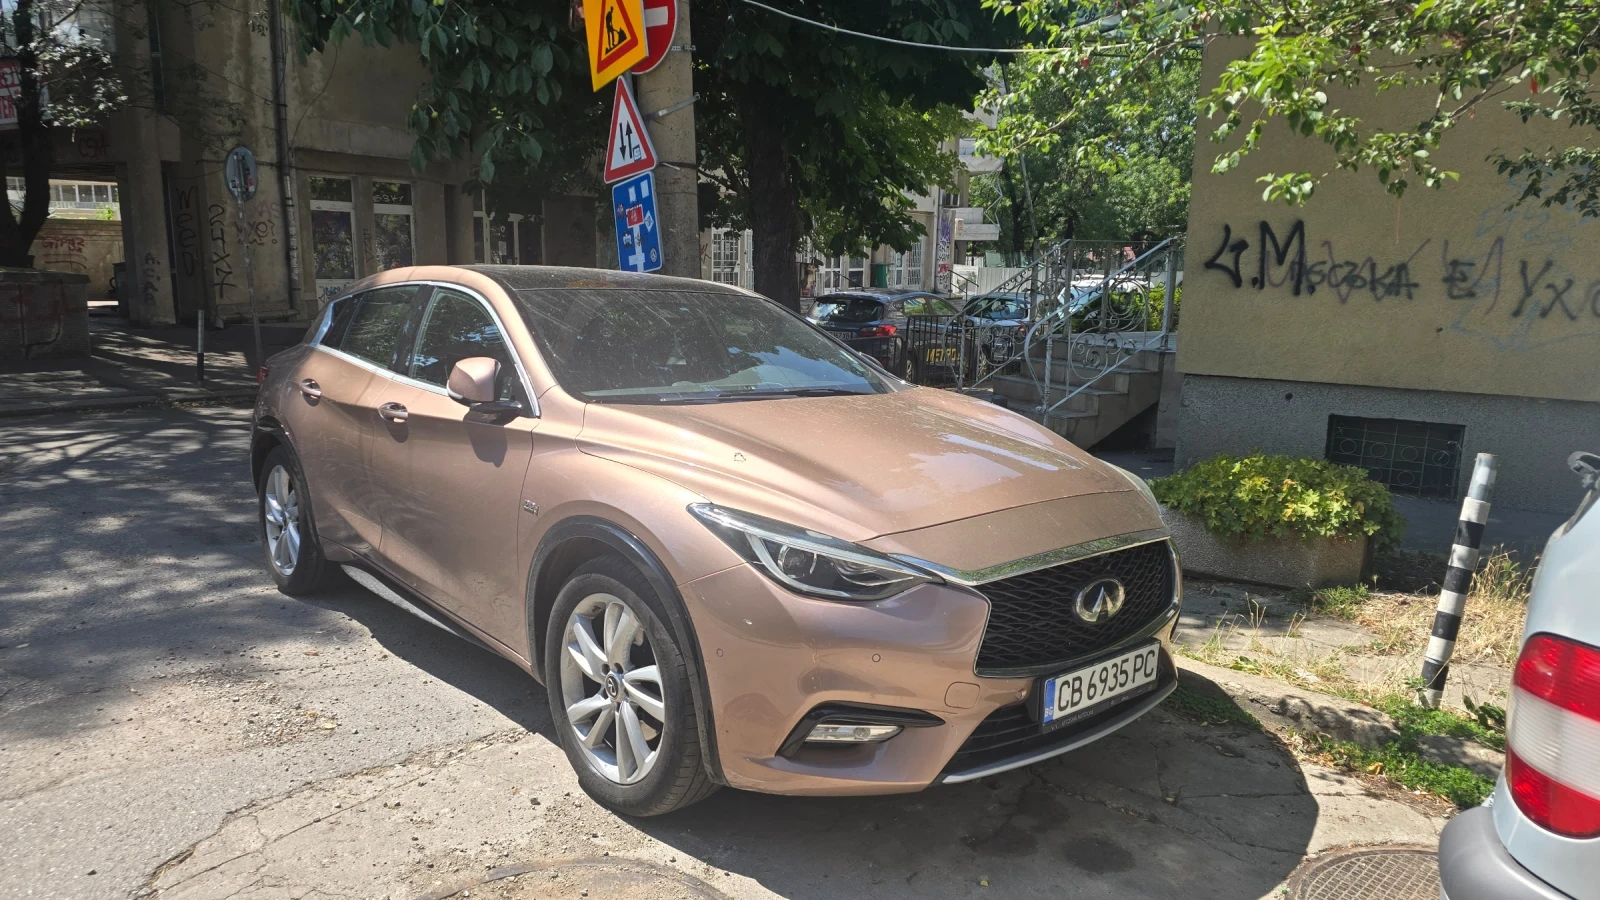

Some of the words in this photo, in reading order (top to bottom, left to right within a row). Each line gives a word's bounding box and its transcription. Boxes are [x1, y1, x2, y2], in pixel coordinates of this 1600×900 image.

[175, 186, 197, 278] WEED
[1044, 706, 1054, 718] BG
[1057, 675, 1083, 712] CB
[1086, 657, 1129, 701] 6935
[1130, 649, 1156, 684] PC
